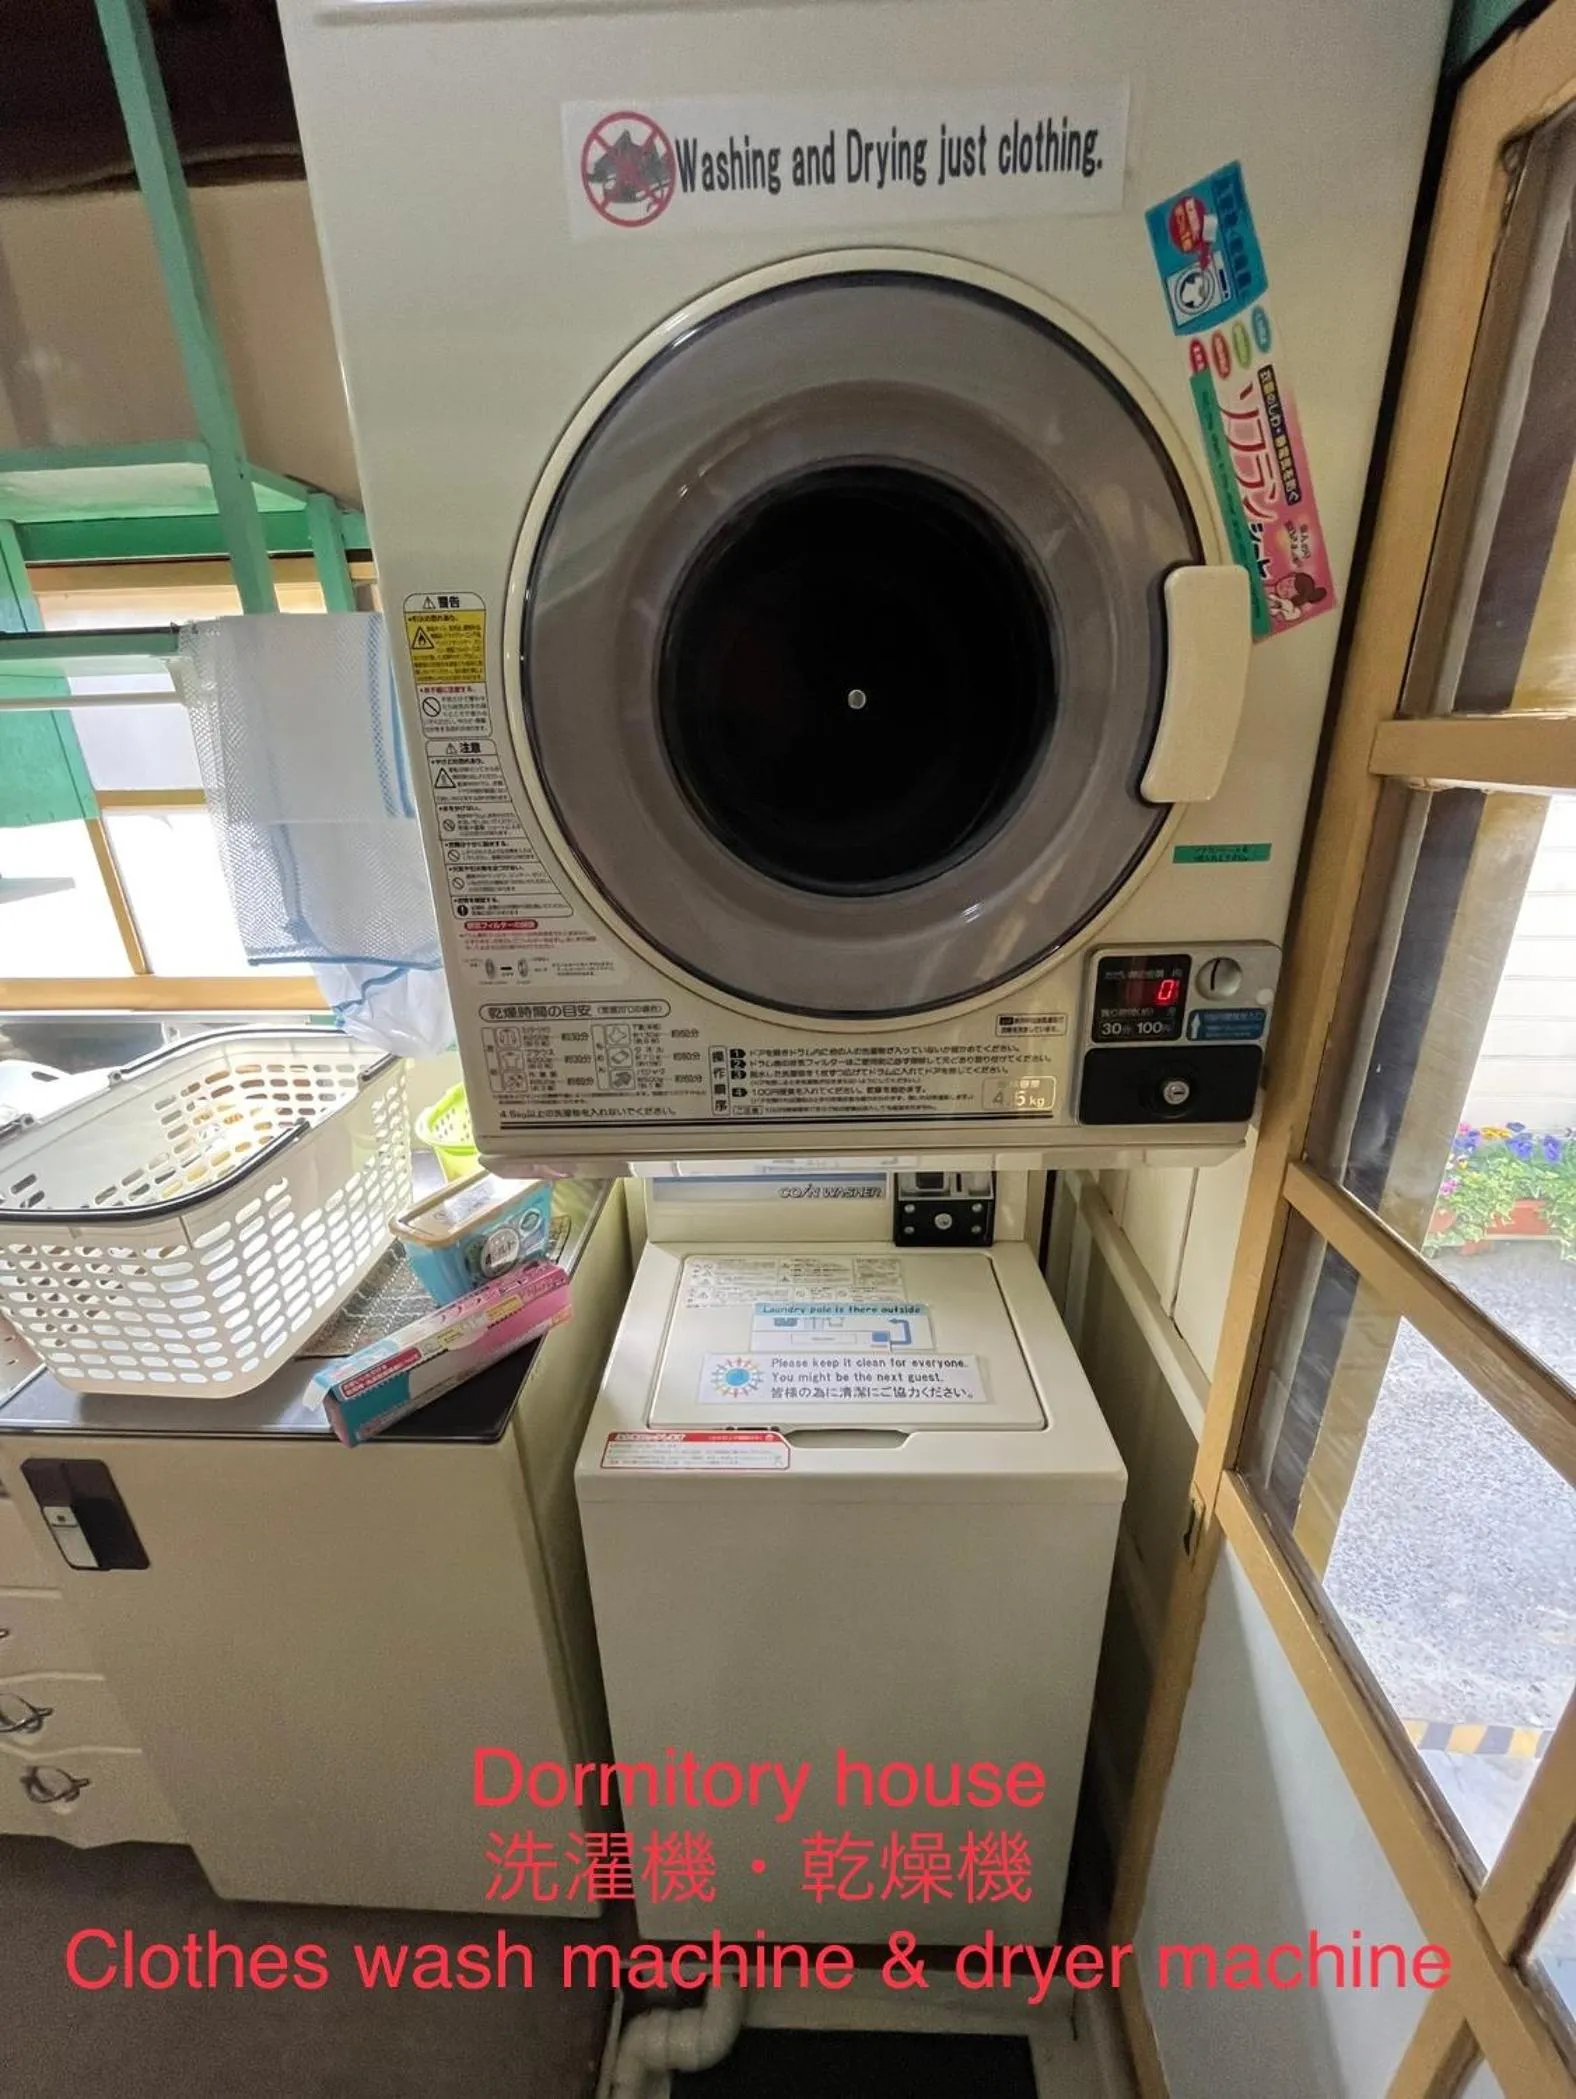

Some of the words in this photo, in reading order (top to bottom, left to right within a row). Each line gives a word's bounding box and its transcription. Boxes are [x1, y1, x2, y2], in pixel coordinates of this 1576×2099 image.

[674, 134, 781, 196] Washing
[792, 129, 835, 186] and
[846, 127, 927, 190] Drying
[938, 123, 987, 186] just
[998, 116, 1103, 178] clothing.
[1157, 979, 1176, 1001] 0
[778, 1182, 821, 1199] COIN
[822, 1186, 883, 1199] WASHER
[763, 1305, 805, 1315] Laundry
[810, 1304, 832, 1315] pole
[835, 1304, 844, 1314] is
[849, 1304, 878, 1314] there
[880, 1304, 921, 1314] outside
[771, 1357, 809, 1368] Please
[812, 1357, 840, 1370] keep
[843, 1357, 852, 1368] it
[855, 1357, 887, 1368] clean
[890, 1357, 907, 1368] for
[911, 1358, 969, 1370] everyone.
[771, 1372, 794, 1383] You
[798, 1372, 832, 1384] might
[835, 1372, 850, 1383] be
[853, 1372, 873, 1383] the
[876, 1373, 904, 1383] next
[907, 1373, 945, 1385] guest.
[770, 1386, 974, 1399] 皆様の為に清潔にご協力ください。
